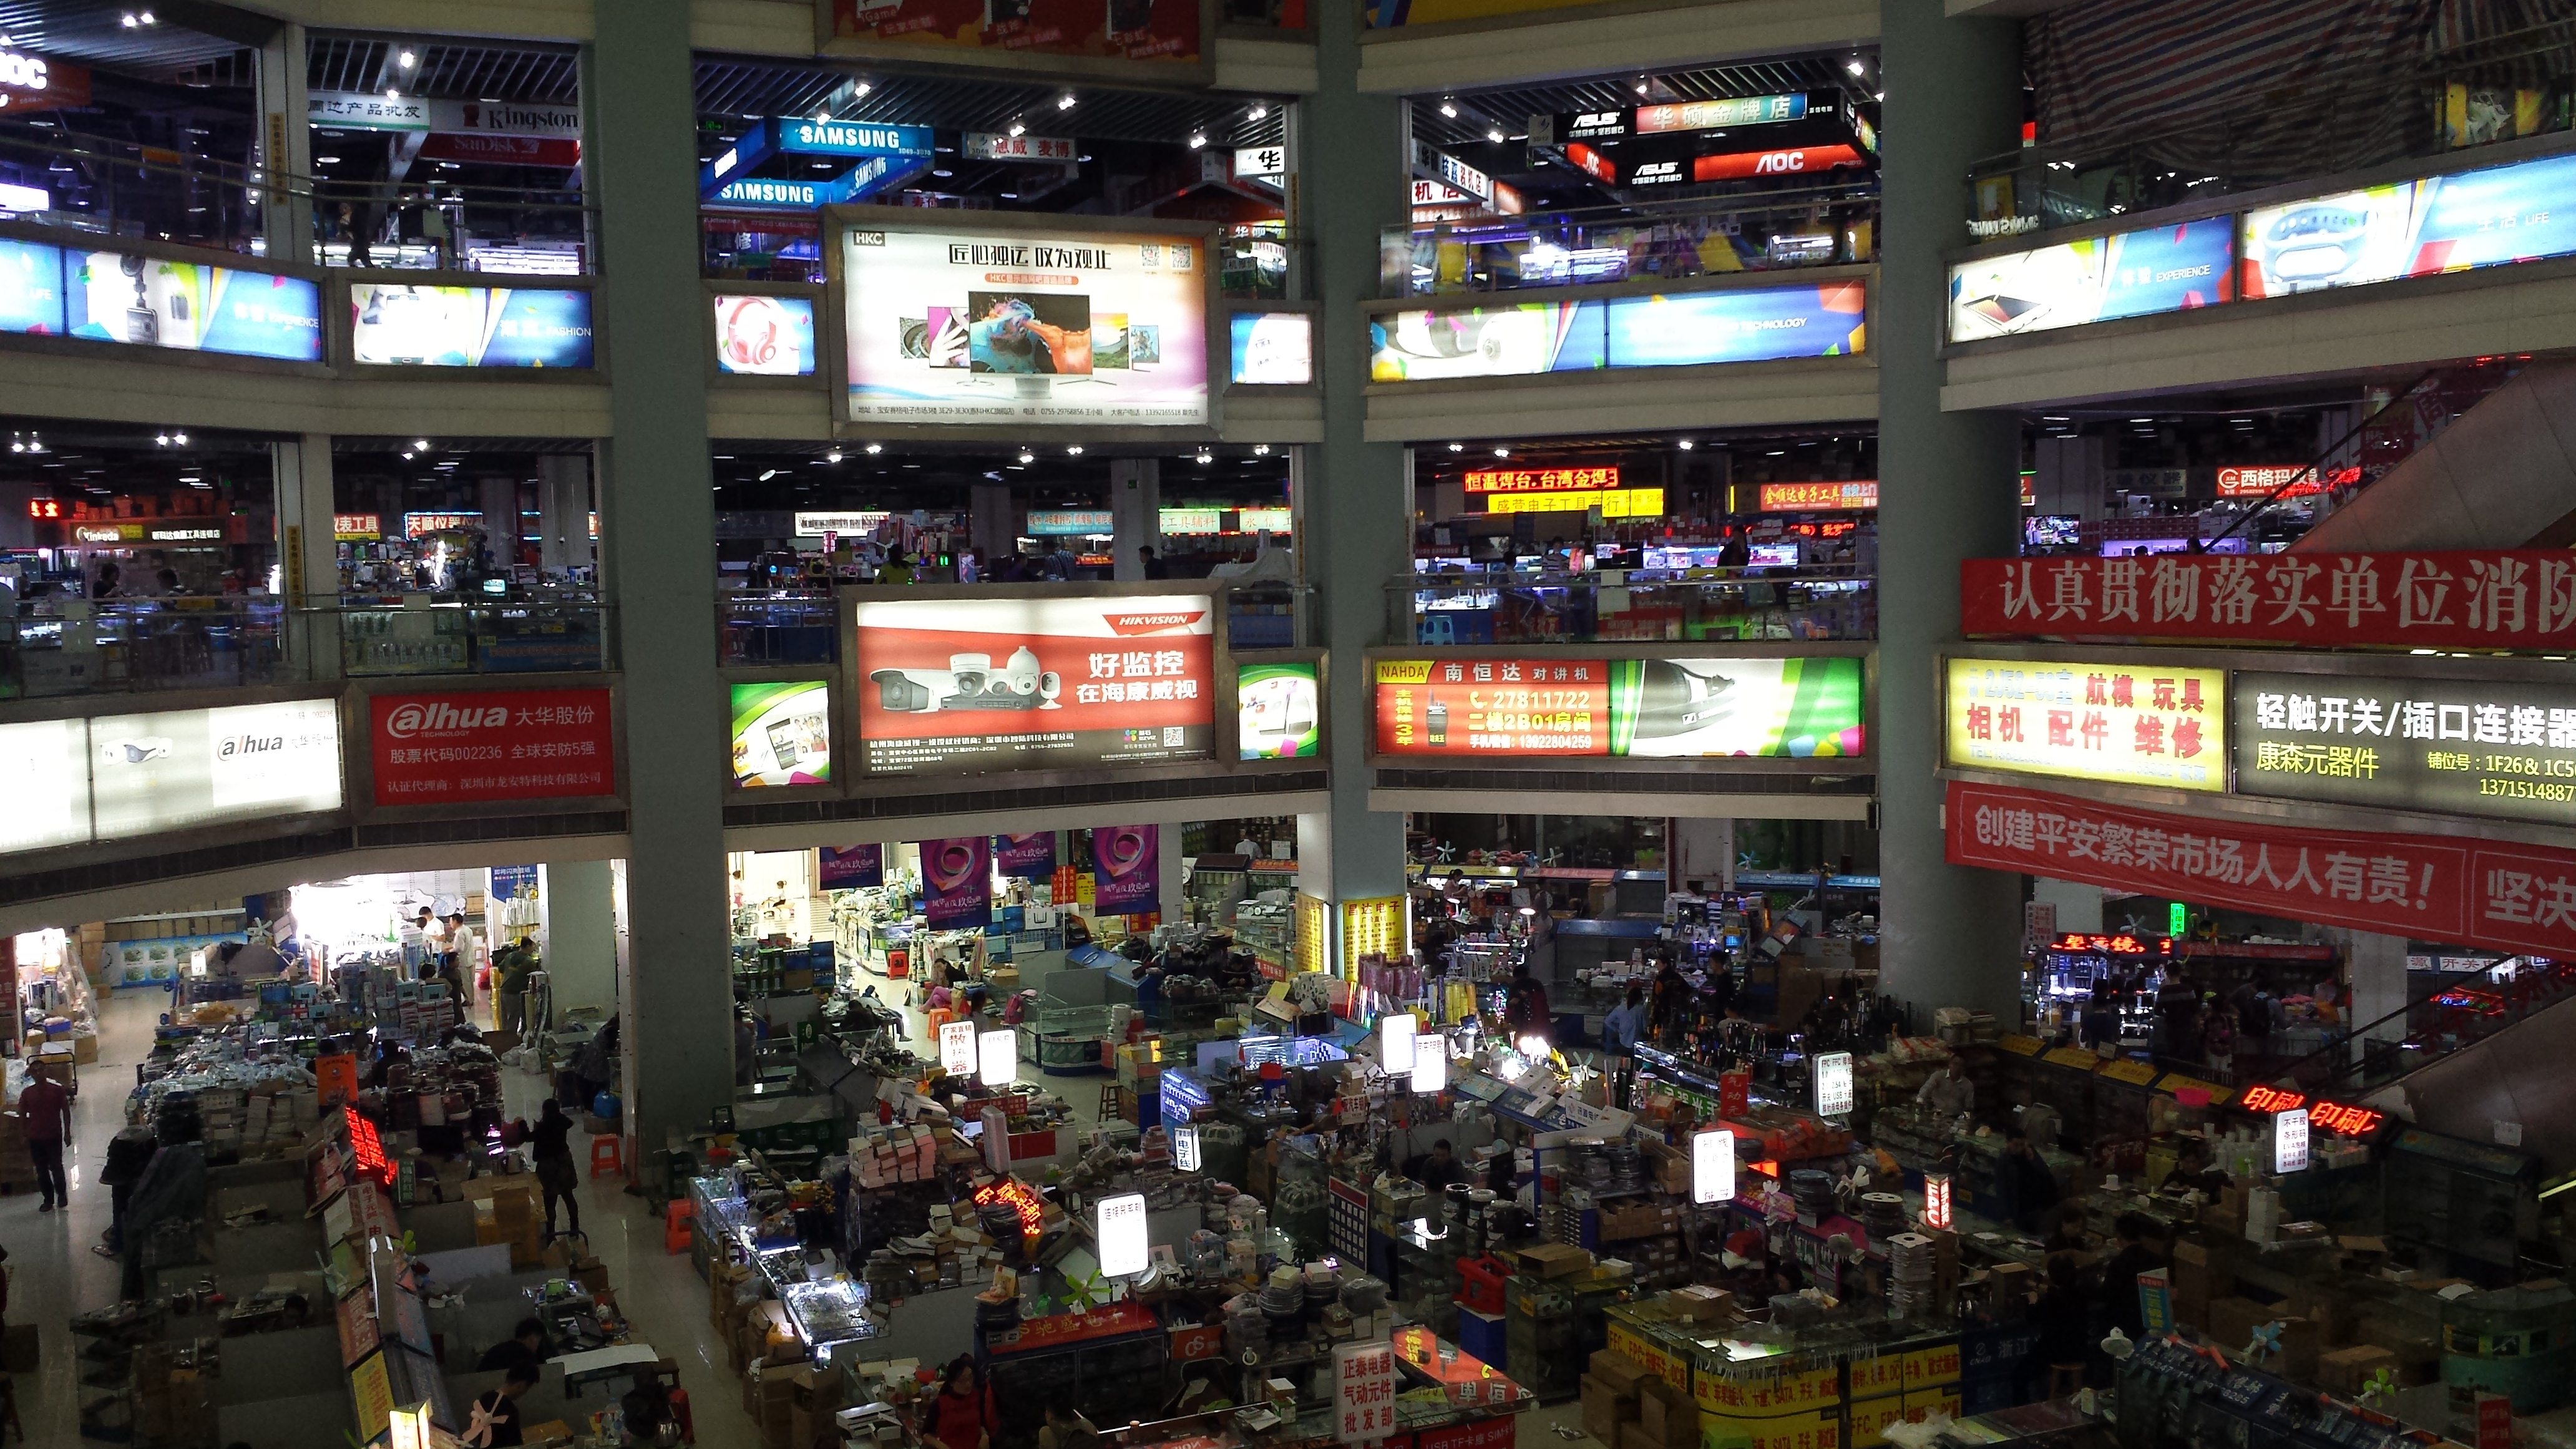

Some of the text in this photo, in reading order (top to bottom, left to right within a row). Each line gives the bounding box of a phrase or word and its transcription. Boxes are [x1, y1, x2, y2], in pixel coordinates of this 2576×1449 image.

[0, 52, 47, 90] OC
[488, 107, 578, 129] Kingston
[1572, 111, 1621, 129] ASUS
[1652, 95, 1791, 130] 华硕金牌店
[455, 136, 515, 152] SanDisk
[801, 125, 899, 149] SAMSUNG
[995, 138, 1070, 157] 惠威 麦博
[1259, 150, 1280, 170] 华
[1635, 162, 1679, 177] ASUS
[1755, 152, 1804, 173] AOC
[721, 183, 814, 203] SAMSUNG
[2525, 210, 2550, 226] LIFE
[856, 233, 884, 245] HKC
[949, 243, 1112, 270] 匠心独运 叹为观止
[2156, 265, 2211, 283] EXPERIENCE
[546, 327, 592, 336] FASHION
[1764, 485, 1840, 505] 金顺达电子工具
[1161, 510, 1216, 529] 工具辅料
[1999, 555, 2576, 635] 认真贯彻落实单位消防
[1119, 615, 1188, 626] HIKVISION
[1088, 650, 1185, 679] 好监控
[1381, 663, 1589, 682] NAHDA 南恒达 对讲机
[1076, 680, 1198, 704] 在海康威视
[1493, 691, 1590, 710] 27811722
[2085, 673, 2134, 709] 航模
[2152, 678, 2205, 713] 玩具
[515, 705, 595, 726] 大华股份
[1468, 711, 1592, 733] 二楼2B01房间
[2256, 691, 2576, 749] 轻触开关/插口连接器
[1967, 702, 2203, 759] 相机 配件 维修
[390, 741, 596, 764] 股票代码002236 全球安防5强
[2256, 740, 2380, 780] 康森元器件
[460, 771, 602, 789] 深圳市龙安特科技有限公司
[1348, 900, 1400, 917] 昌达电子
[2486, 868, 2576, 930] 坚决
[2243, 1086, 2306, 1113] 印刷
[2308, 1101, 2373, 1135] 印刷
[2283, 1129, 2307, 1141] 条形码
[1178, 1139, 1191, 1169] 电子线
[1927, 1181, 1940, 1225] FPC
[1035, 1309, 1125, 1337] 驰盛电子
[1344, 1352, 1391, 1380] 正泰电器
[1344, 1378, 1392, 1406] 气动元件
[1344, 1405, 1393, 1434] 批发部
[1451, 1434, 1485, 1447] TF卡座
